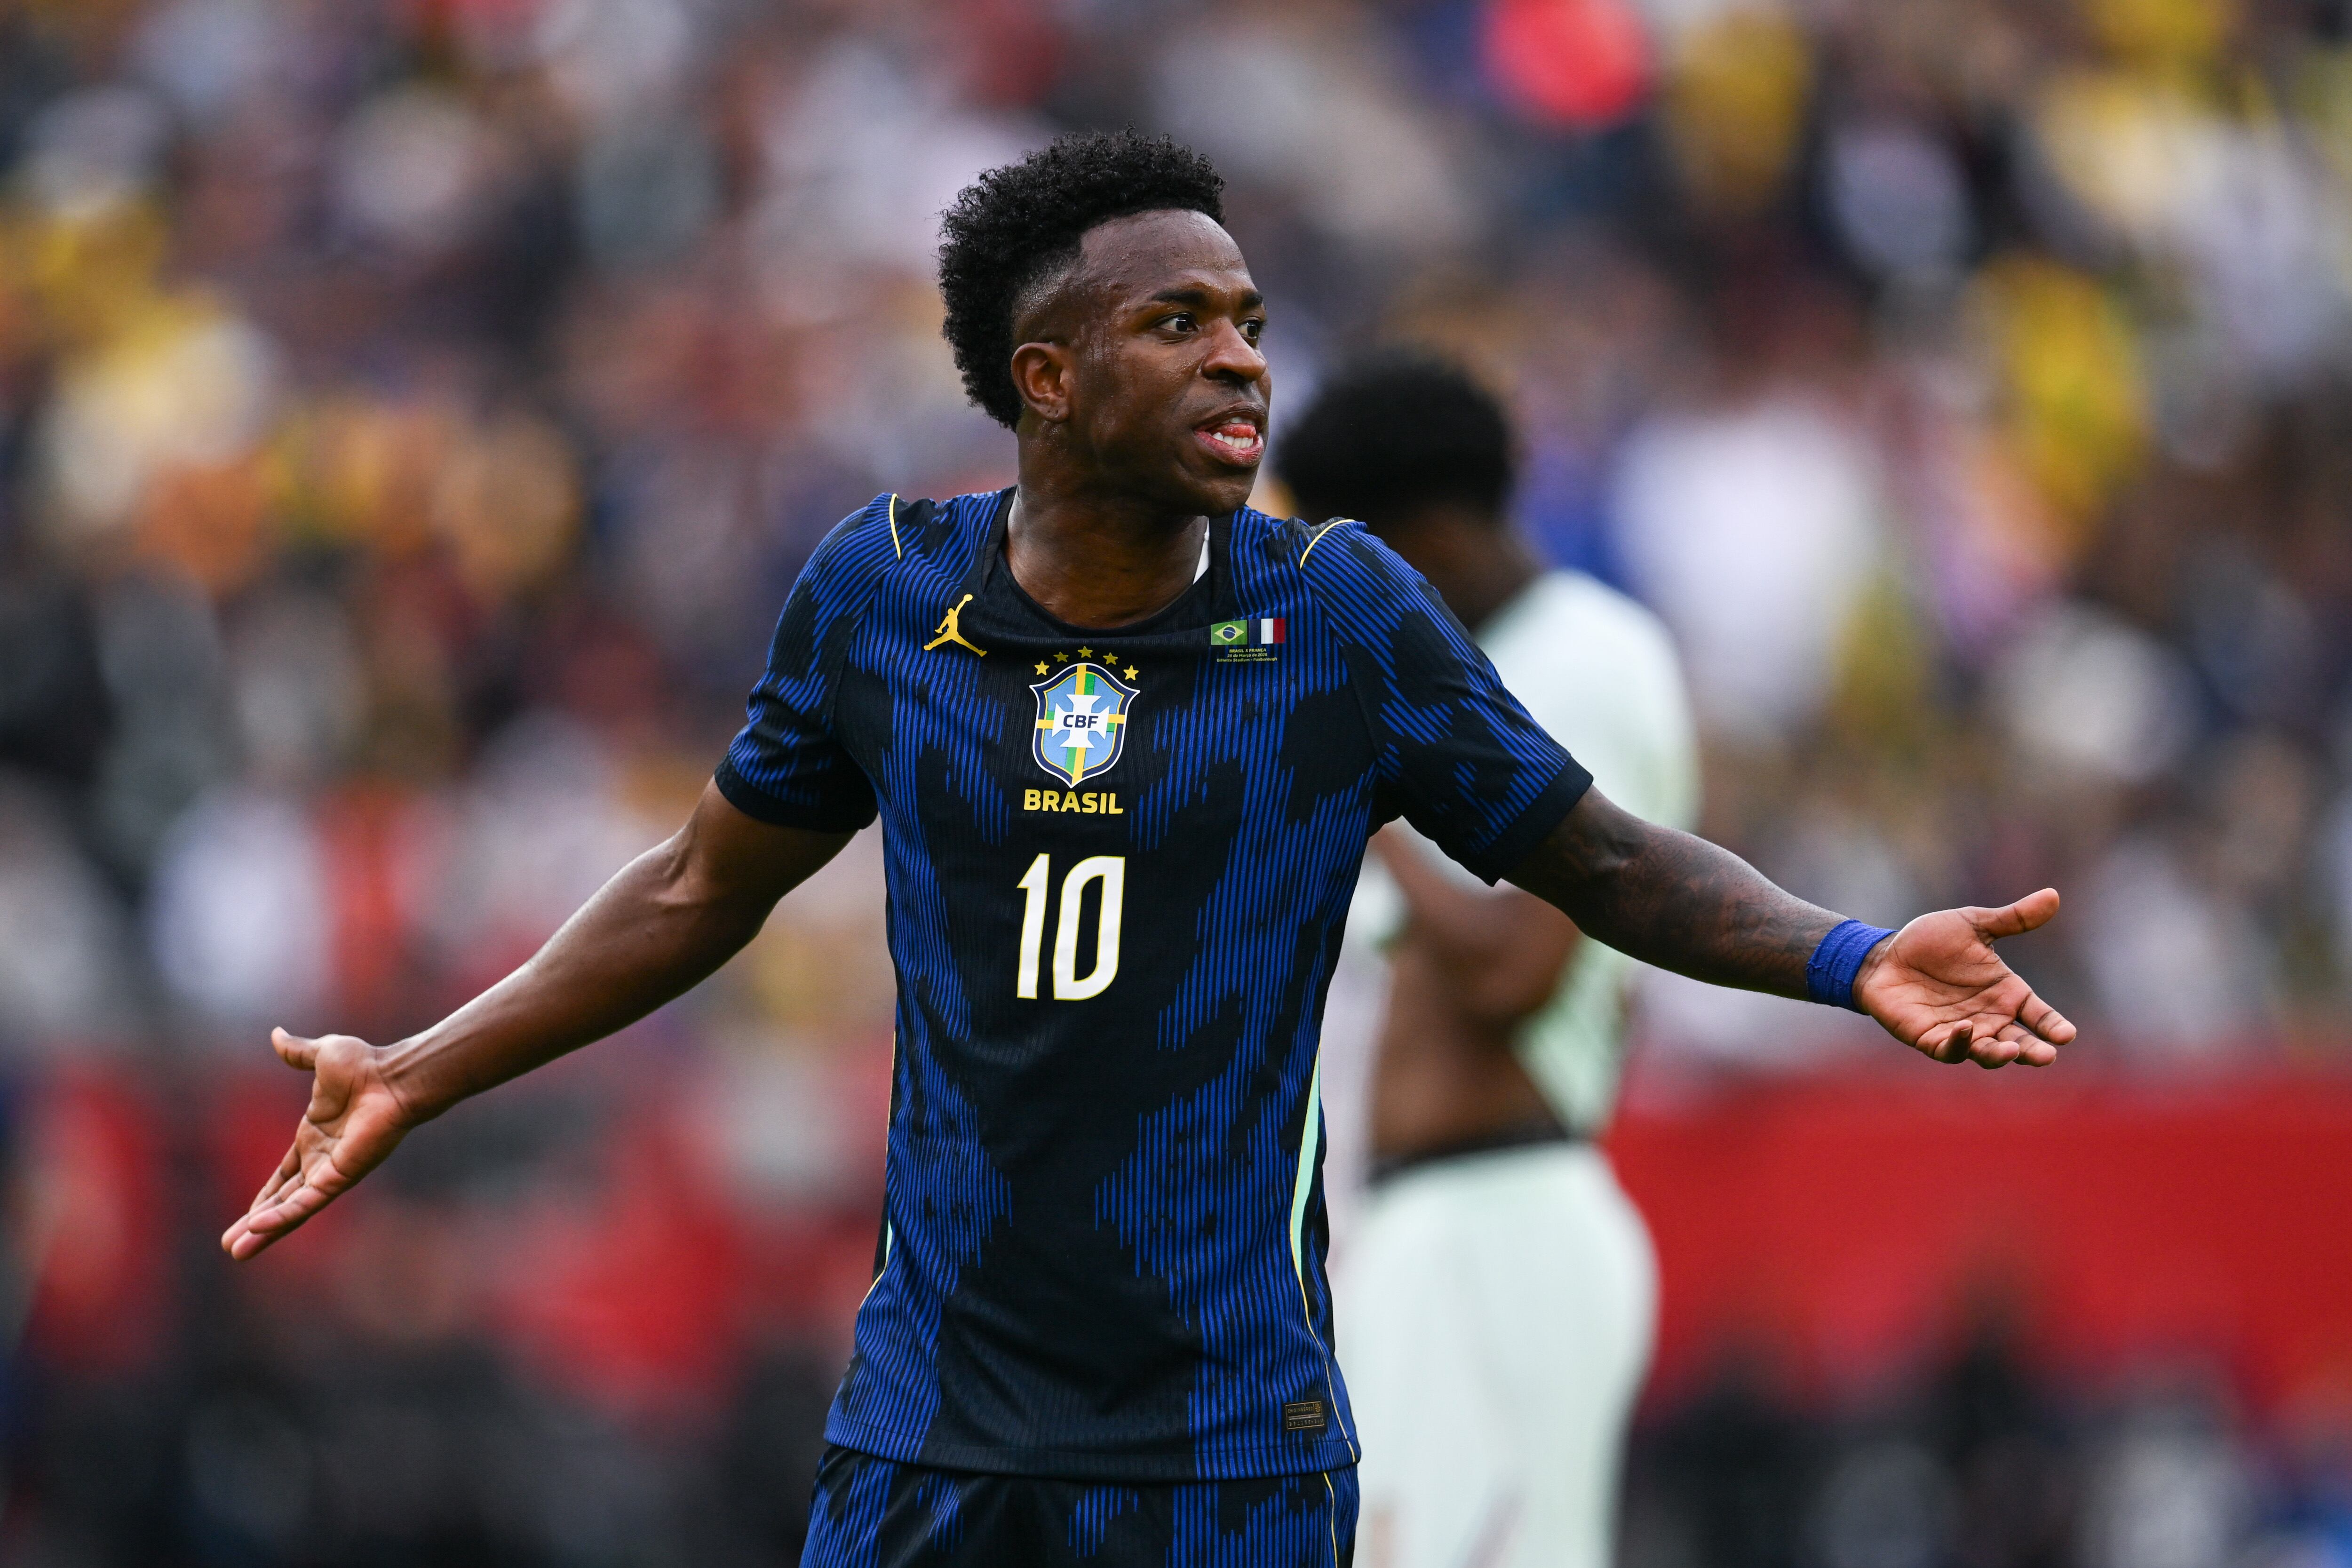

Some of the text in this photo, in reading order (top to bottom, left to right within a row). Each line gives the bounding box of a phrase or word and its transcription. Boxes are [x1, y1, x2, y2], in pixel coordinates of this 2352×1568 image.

[1063, 714, 1099, 729] CBF
[1023, 788, 1124, 815] BRASIL
[1017, 852, 1126, 1001] 10
